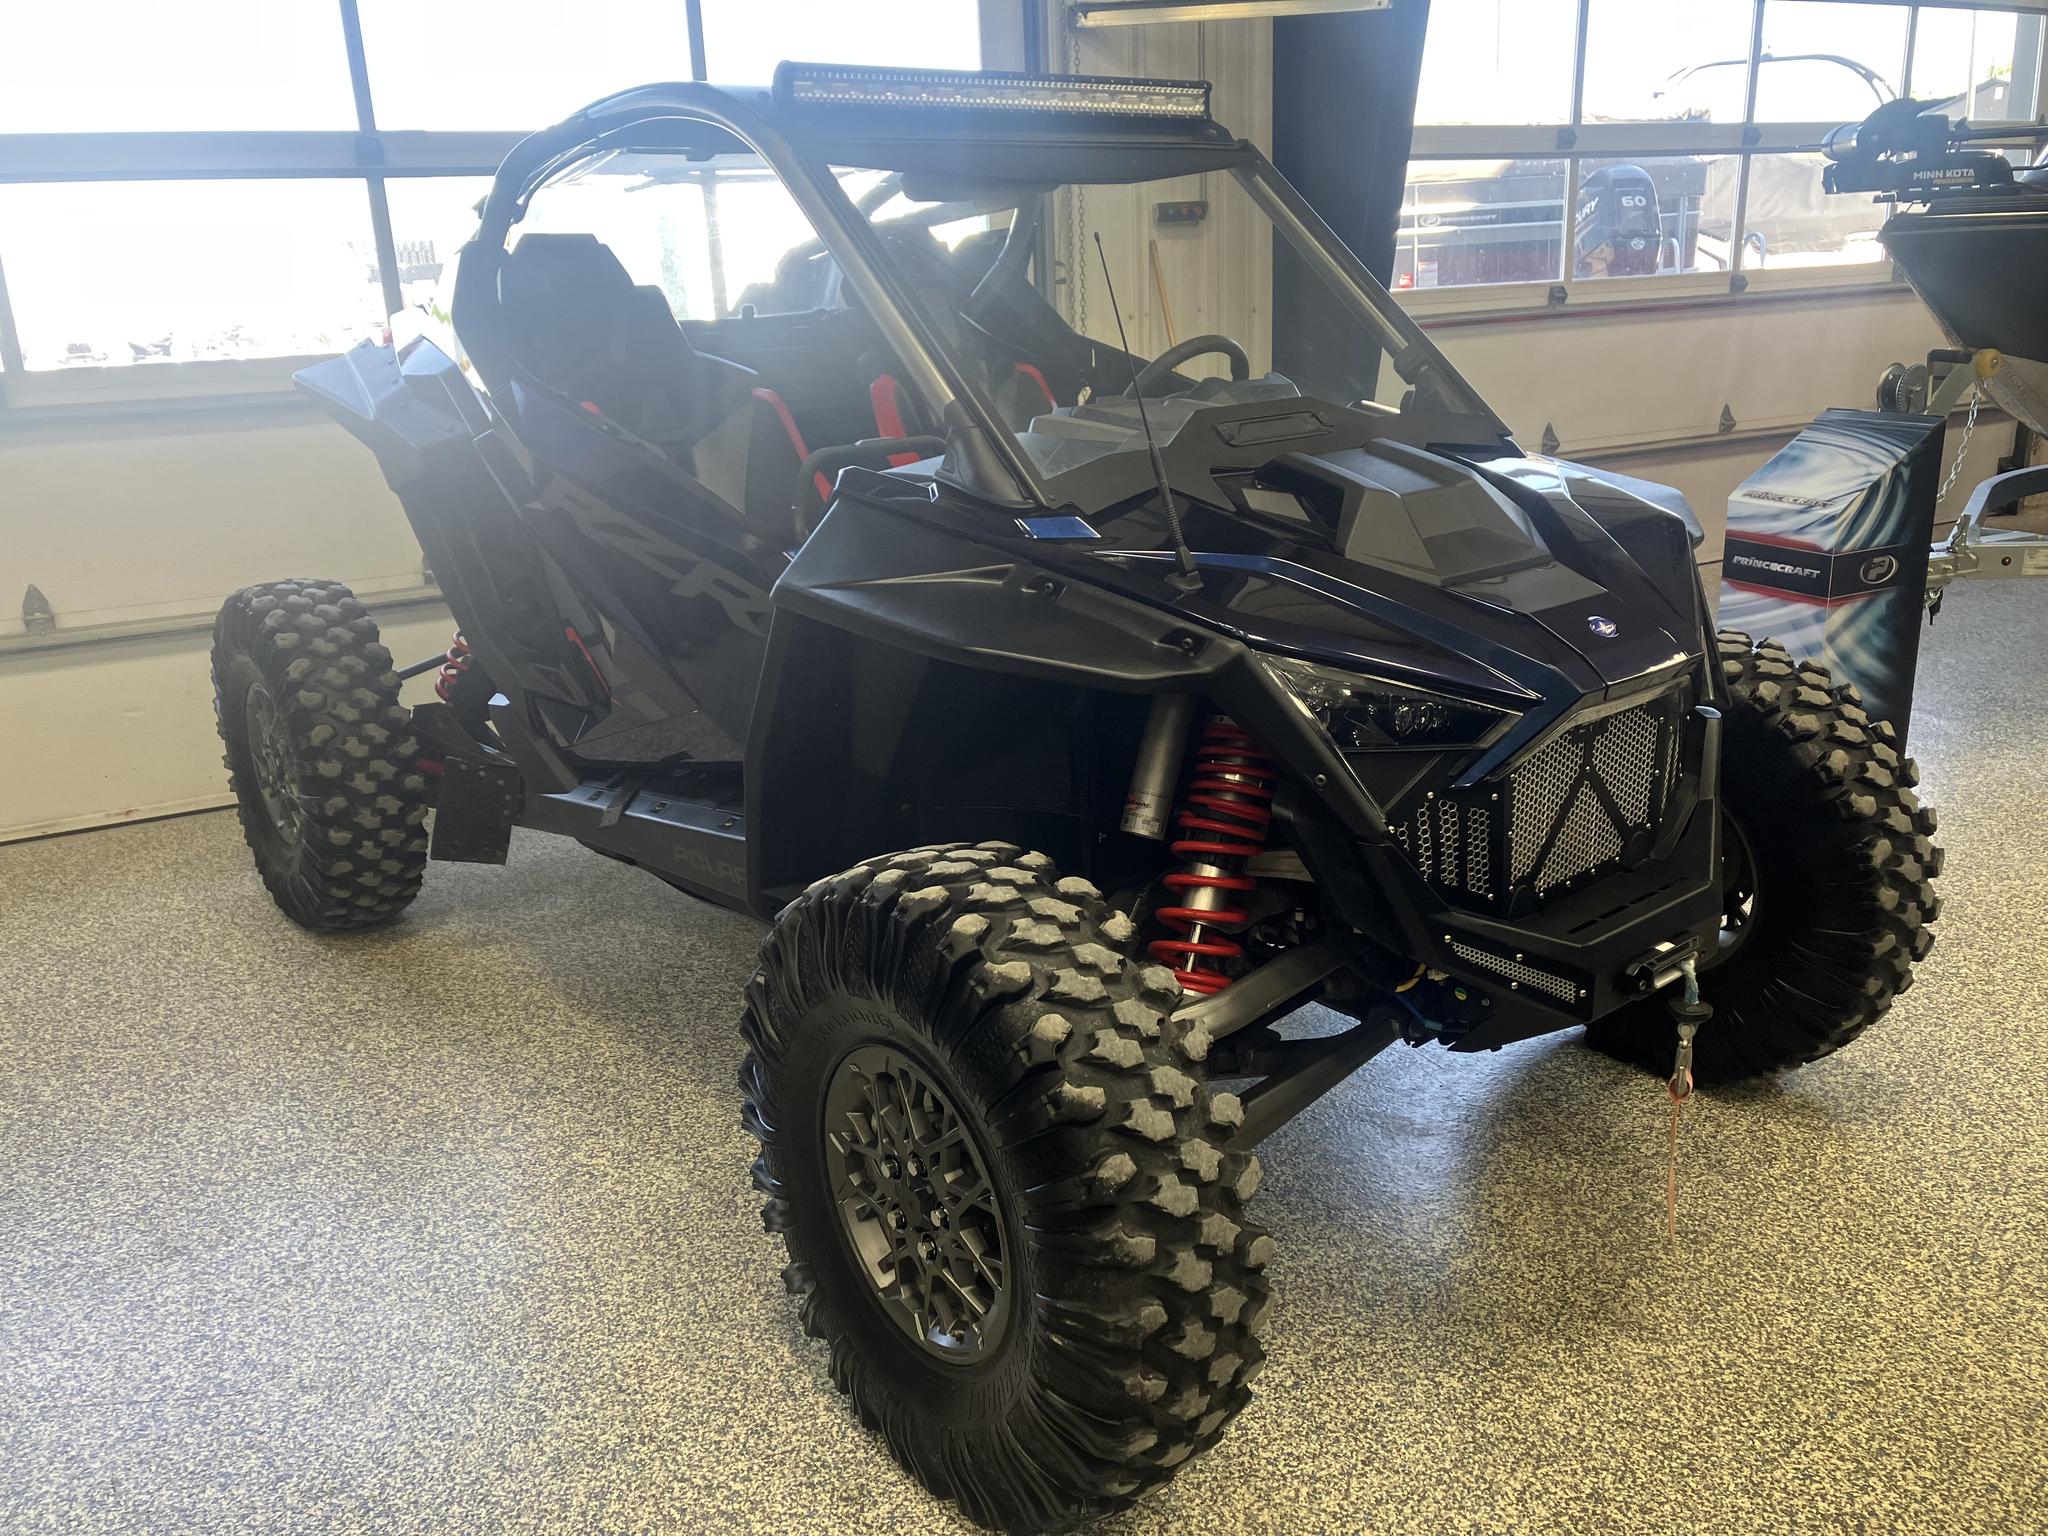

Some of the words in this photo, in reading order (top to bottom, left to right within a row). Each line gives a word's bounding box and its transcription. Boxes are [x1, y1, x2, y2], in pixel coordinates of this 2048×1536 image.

[1913, 170, 1943, 180] MINN
[1946, 168, 1975, 177] KOTA
[1621, 196, 1647, 207] 60
[1732, 555, 1821, 578] PRINCECRAFT
